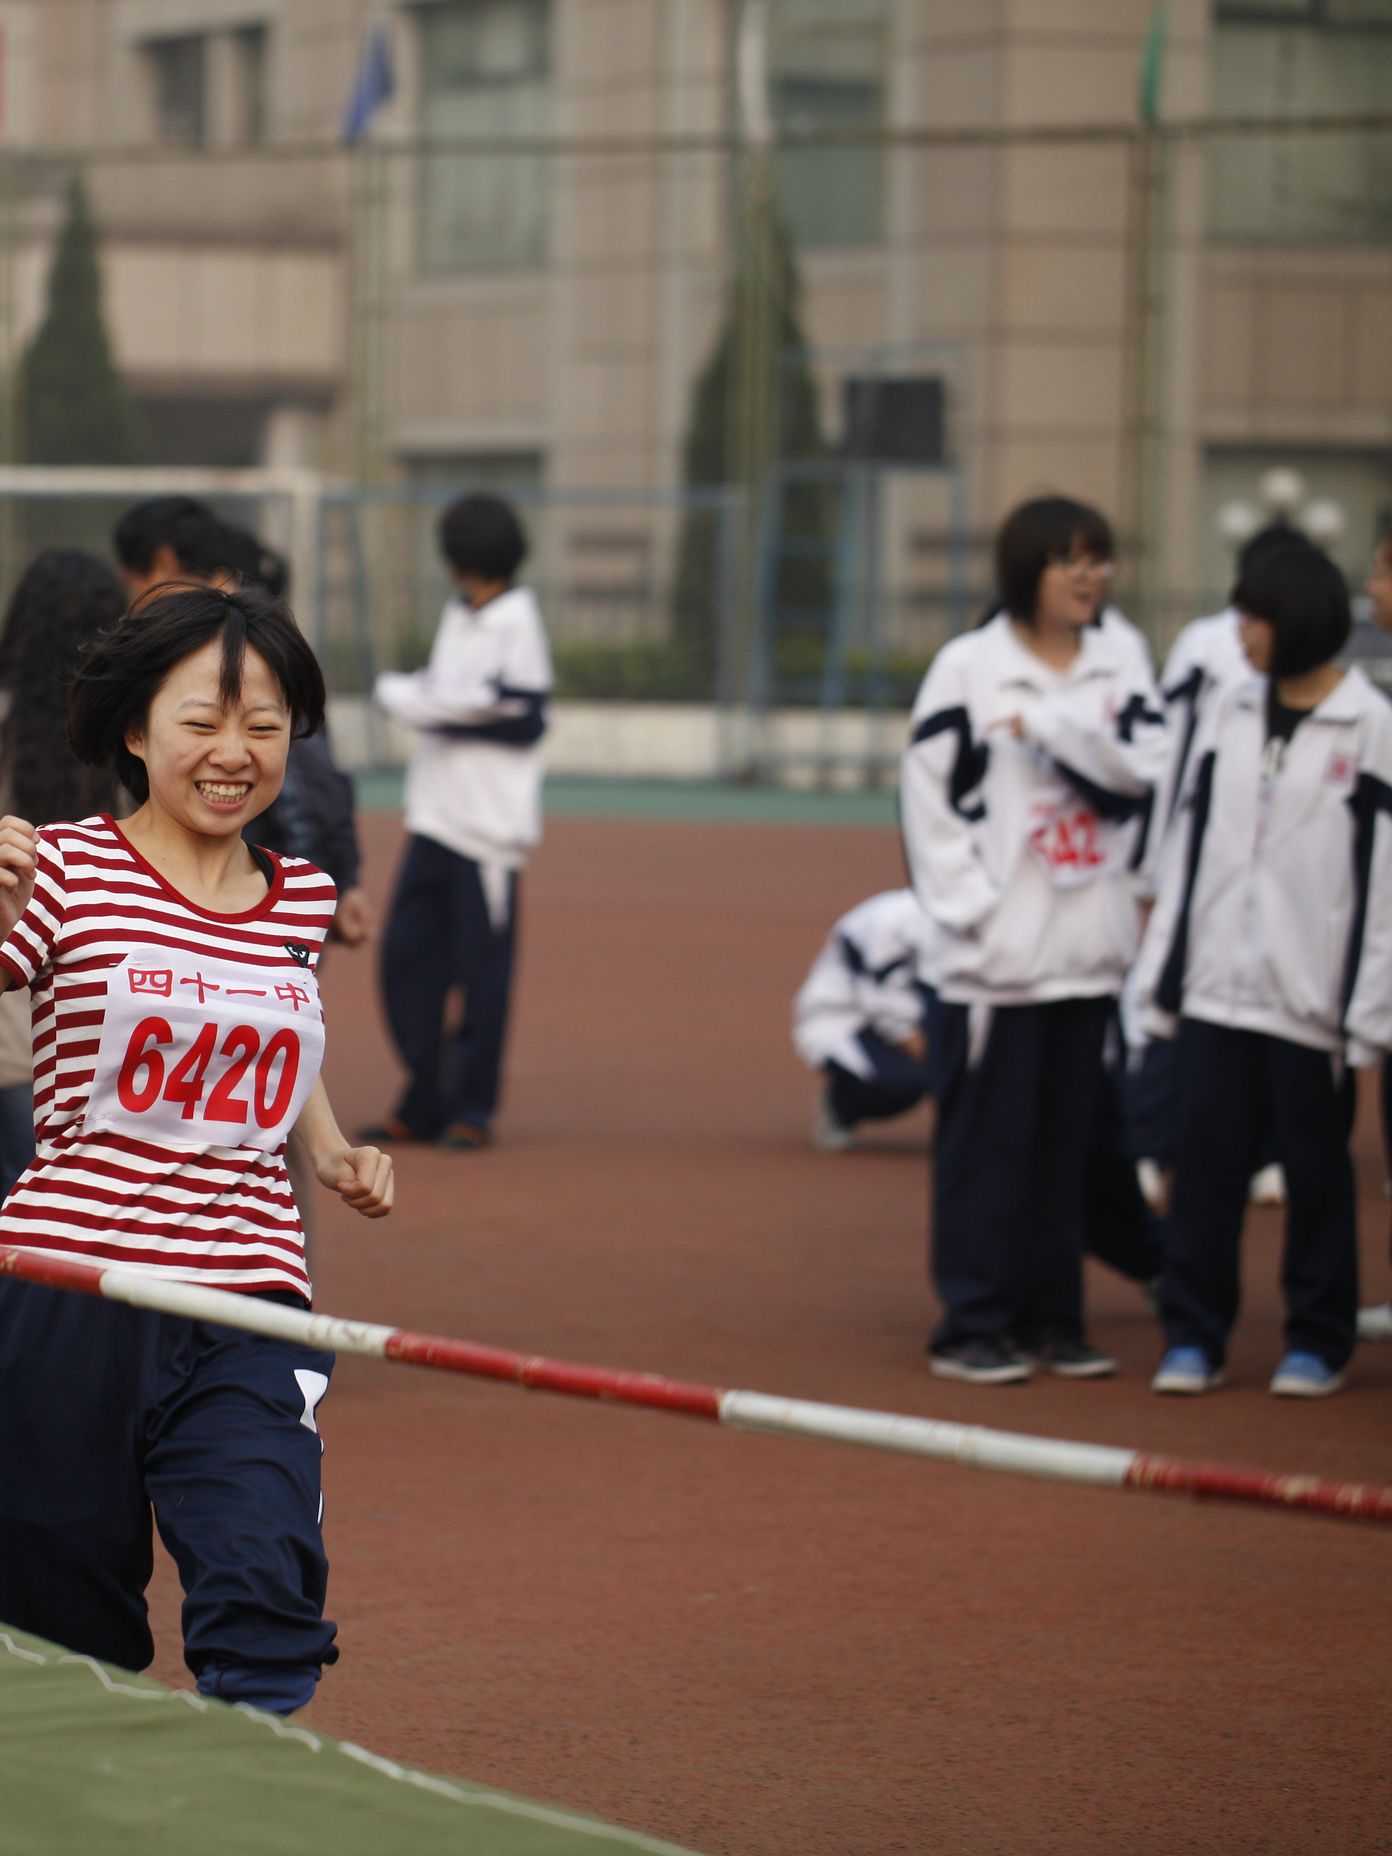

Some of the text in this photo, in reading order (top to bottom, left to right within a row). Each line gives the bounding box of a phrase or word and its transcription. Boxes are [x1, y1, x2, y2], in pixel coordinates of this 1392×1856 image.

[127, 967, 311, 1012] 四十一中
[117, 1016, 301, 1129] 6420
